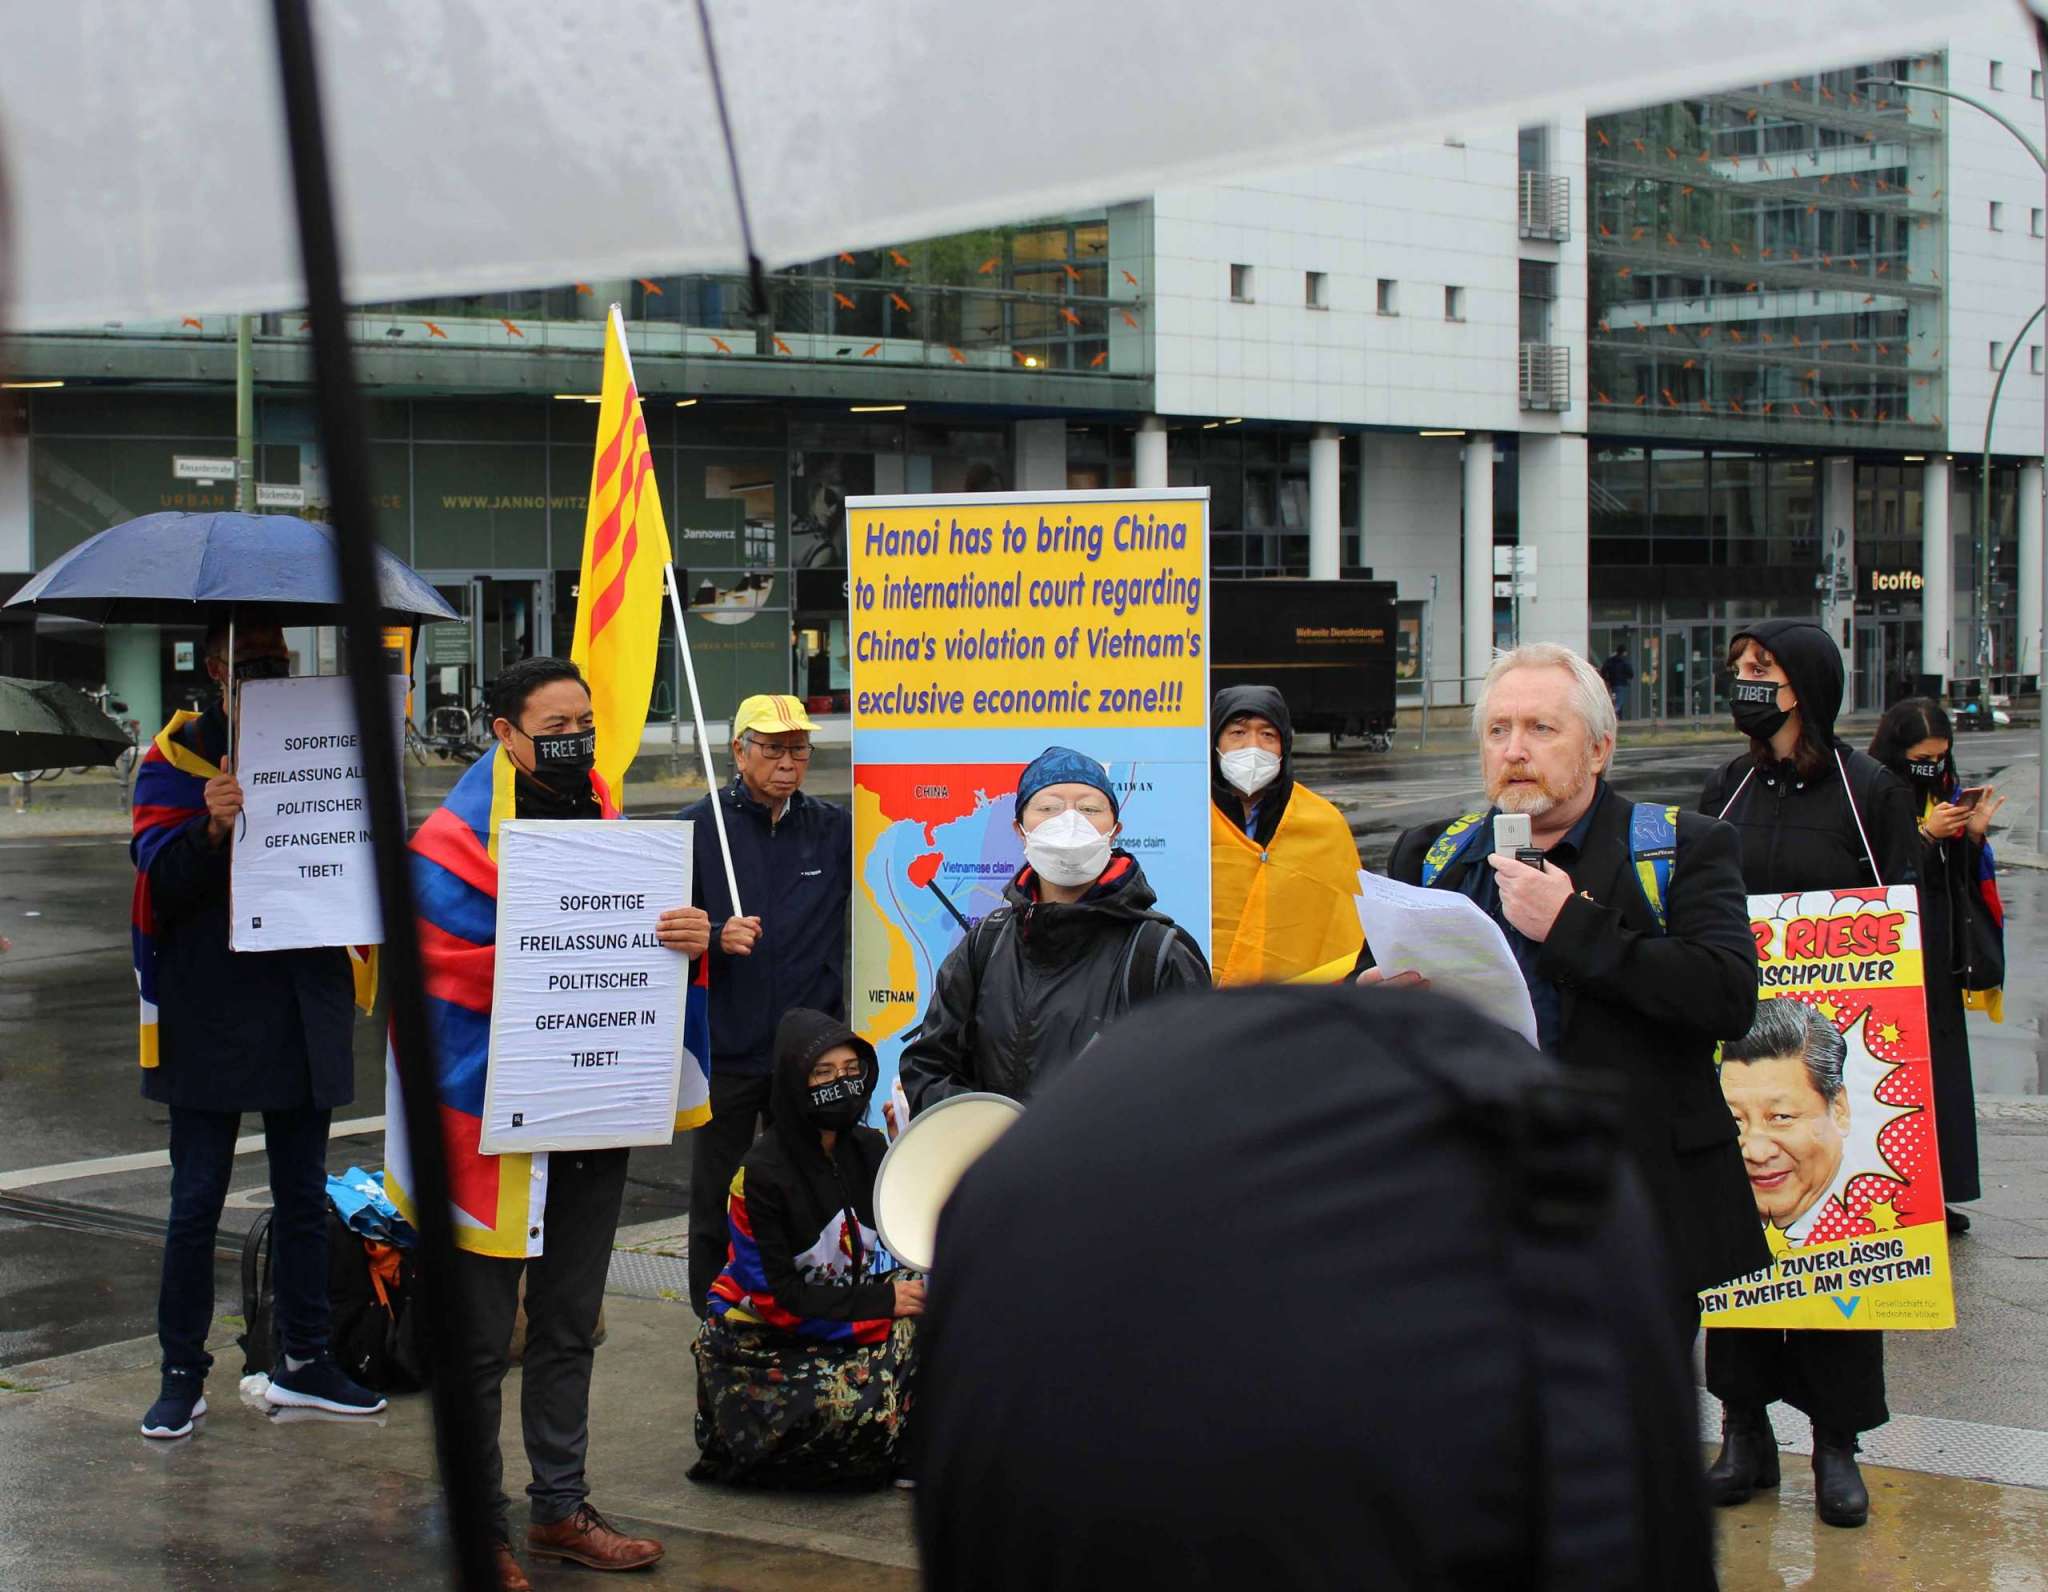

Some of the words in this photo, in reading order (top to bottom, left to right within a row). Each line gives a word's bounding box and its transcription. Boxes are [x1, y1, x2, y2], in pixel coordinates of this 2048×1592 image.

[864, 519, 941, 557] Hanoi
[949, 518, 993, 555] has
[1002, 519, 1027, 554] to
[1037, 515, 1104, 562] bring
[1113, 513, 1187, 551] China
[855, 576, 875, 611] to
[882, 570, 1021, 610] international
[1029, 571, 1086, 608] court
[1092, 567, 1201, 616] regarding
[856, 629, 936, 663] China's
[945, 627, 1046, 661] violation
[1054, 626, 1080, 659] of
[1087, 626, 1201, 659] Vietnam's
[856, 682, 964, 715] exclusive
[973, 680, 1090, 714] economic
[1099, 680, 1184, 713] zone!!!
[1736, 683, 1774, 704] TIBET
[284, 734, 358, 751] SOFORTIGE
[540, 740, 577, 759] FREE
[252, 767, 342, 785] FREILASSUNG
[1910, 763, 1936, 777] FREE
[915, 785, 950, 798] CHINA
[276, 798, 363, 816] POLITISCHER
[265, 830, 355, 848] GEFANGENER
[1113, 835, 1142, 849] hinese
[1143, 835, 1166, 849] claim
[298, 863, 343, 878] TIBET!
[942, 861, 991, 874] Vietnamese
[993, 861, 1015, 874] claim
[559, 894, 645, 911] SOFORTIGE
[520, 934, 628, 952] FREILASSUNG
[1785, 912, 1905, 961] RIESE
[549, 972, 648, 990] POLITISCHER
[868, 989, 915, 1003] VIETNAM
[535, 1011, 637, 1031] GEFANGENER
[641, 1010, 656, 1025] IN
[571, 1051, 619, 1068] TIBET!
[810, 1084, 844, 1106] FREE
[1779, 1239, 1904, 1278] ZUVERLÄSSIG
[1732, 1279, 1808, 1309] ZWEIFEL
[1813, 1272, 1843, 1295] AM
[1849, 1255, 1931, 1288] SYSTEM!
